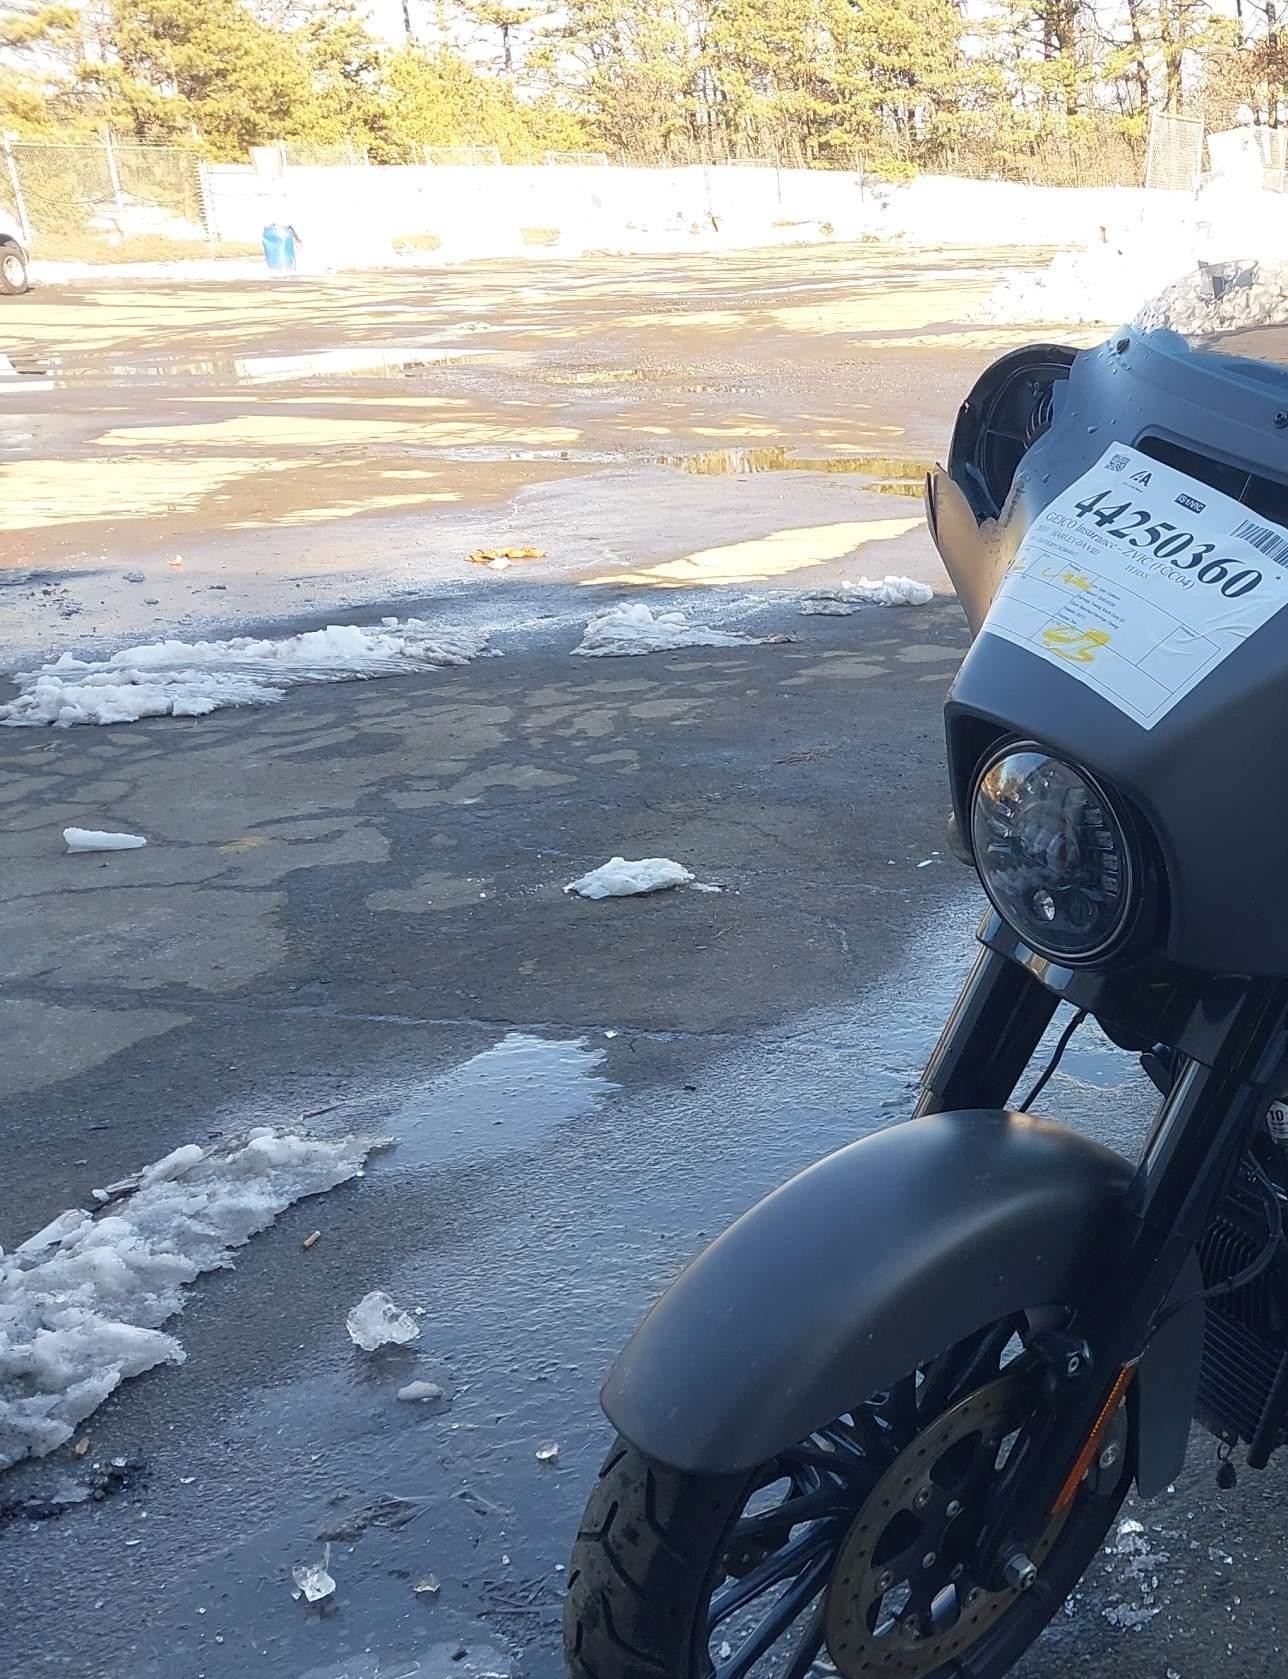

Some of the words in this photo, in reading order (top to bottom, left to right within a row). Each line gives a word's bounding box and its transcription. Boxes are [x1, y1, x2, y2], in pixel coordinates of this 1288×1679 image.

[1046, 511, 1079, 532] GEICO
[1075, 521, 1118, 549] Insurance
[1122, 547, 1153, 568] ZVIC
[1151, 561, 1195, 592] (FCC04)
[1073, 489, 1263, 598] 44250360
